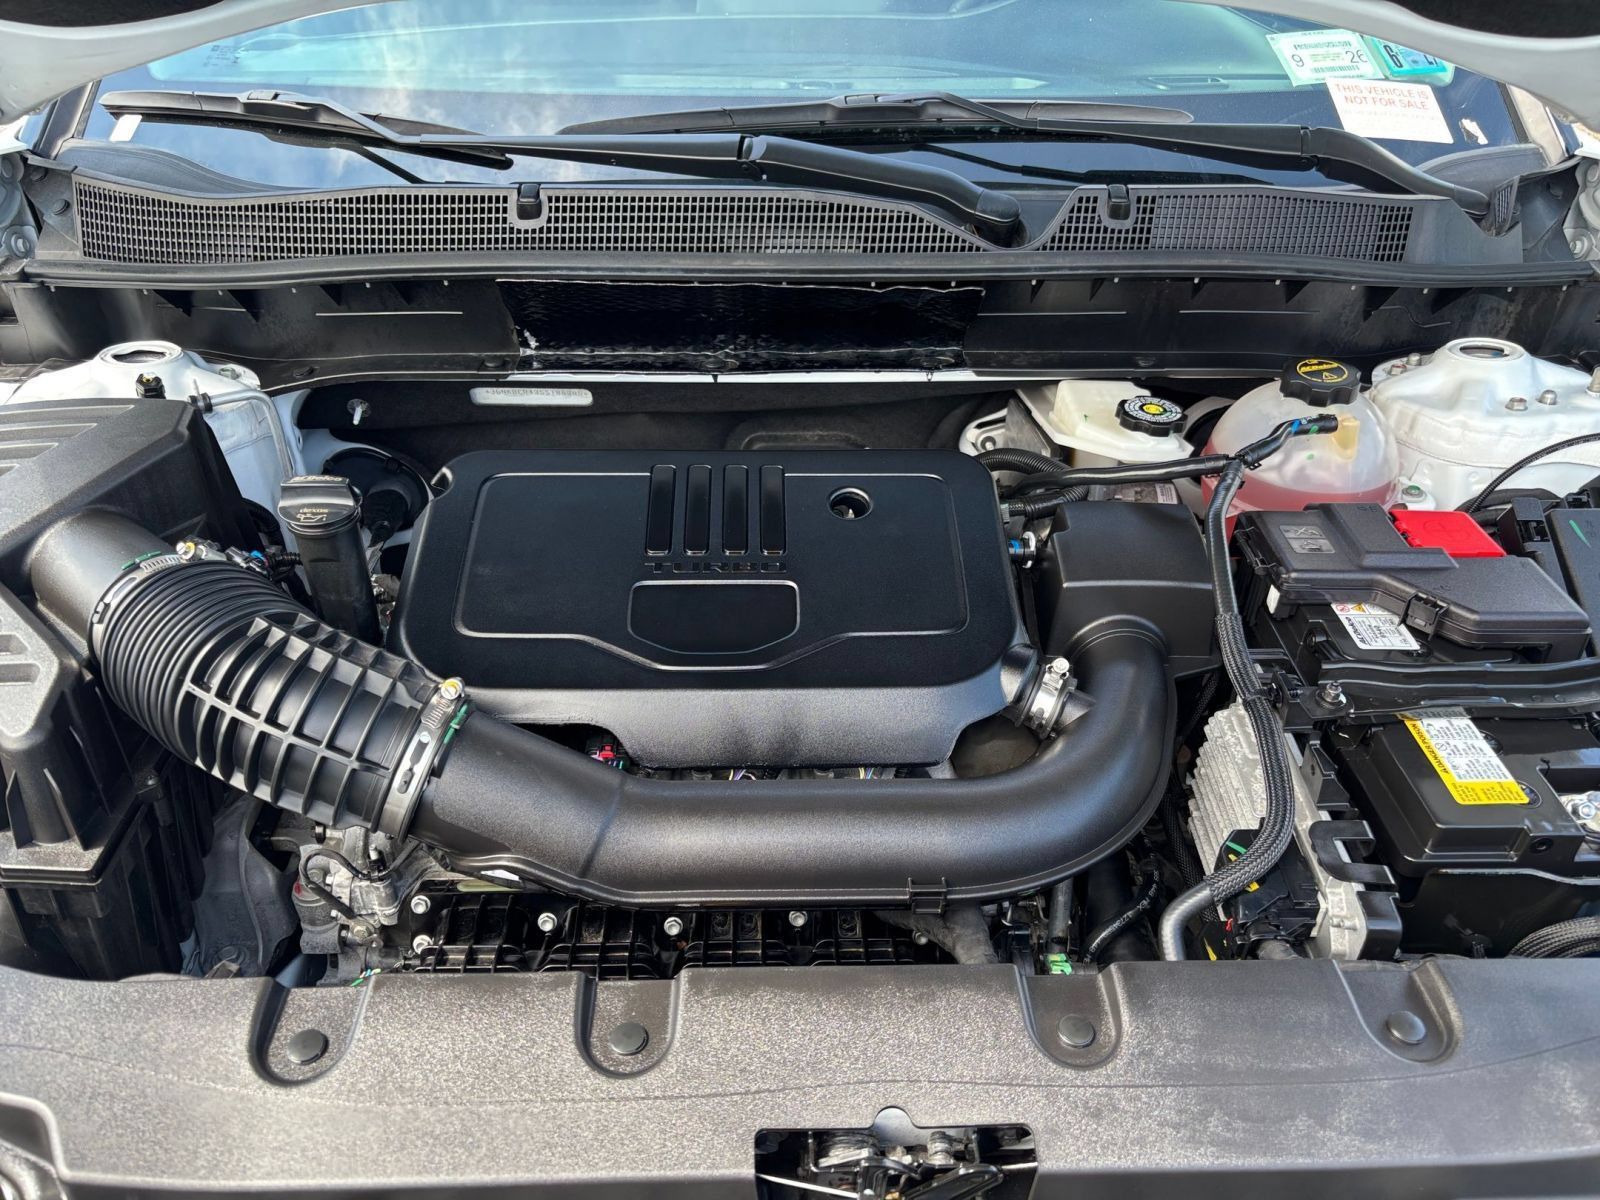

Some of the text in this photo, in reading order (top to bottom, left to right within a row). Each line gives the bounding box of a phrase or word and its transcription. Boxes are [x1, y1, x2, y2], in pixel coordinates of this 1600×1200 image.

[1291, 54, 1305, 68] 9
[1335, 83, 1429, 100] THIS VEHICLE IS
[1344, 95, 1430, 111] NOT FOR SALE
[644, 562, 787, 574] TURBO
